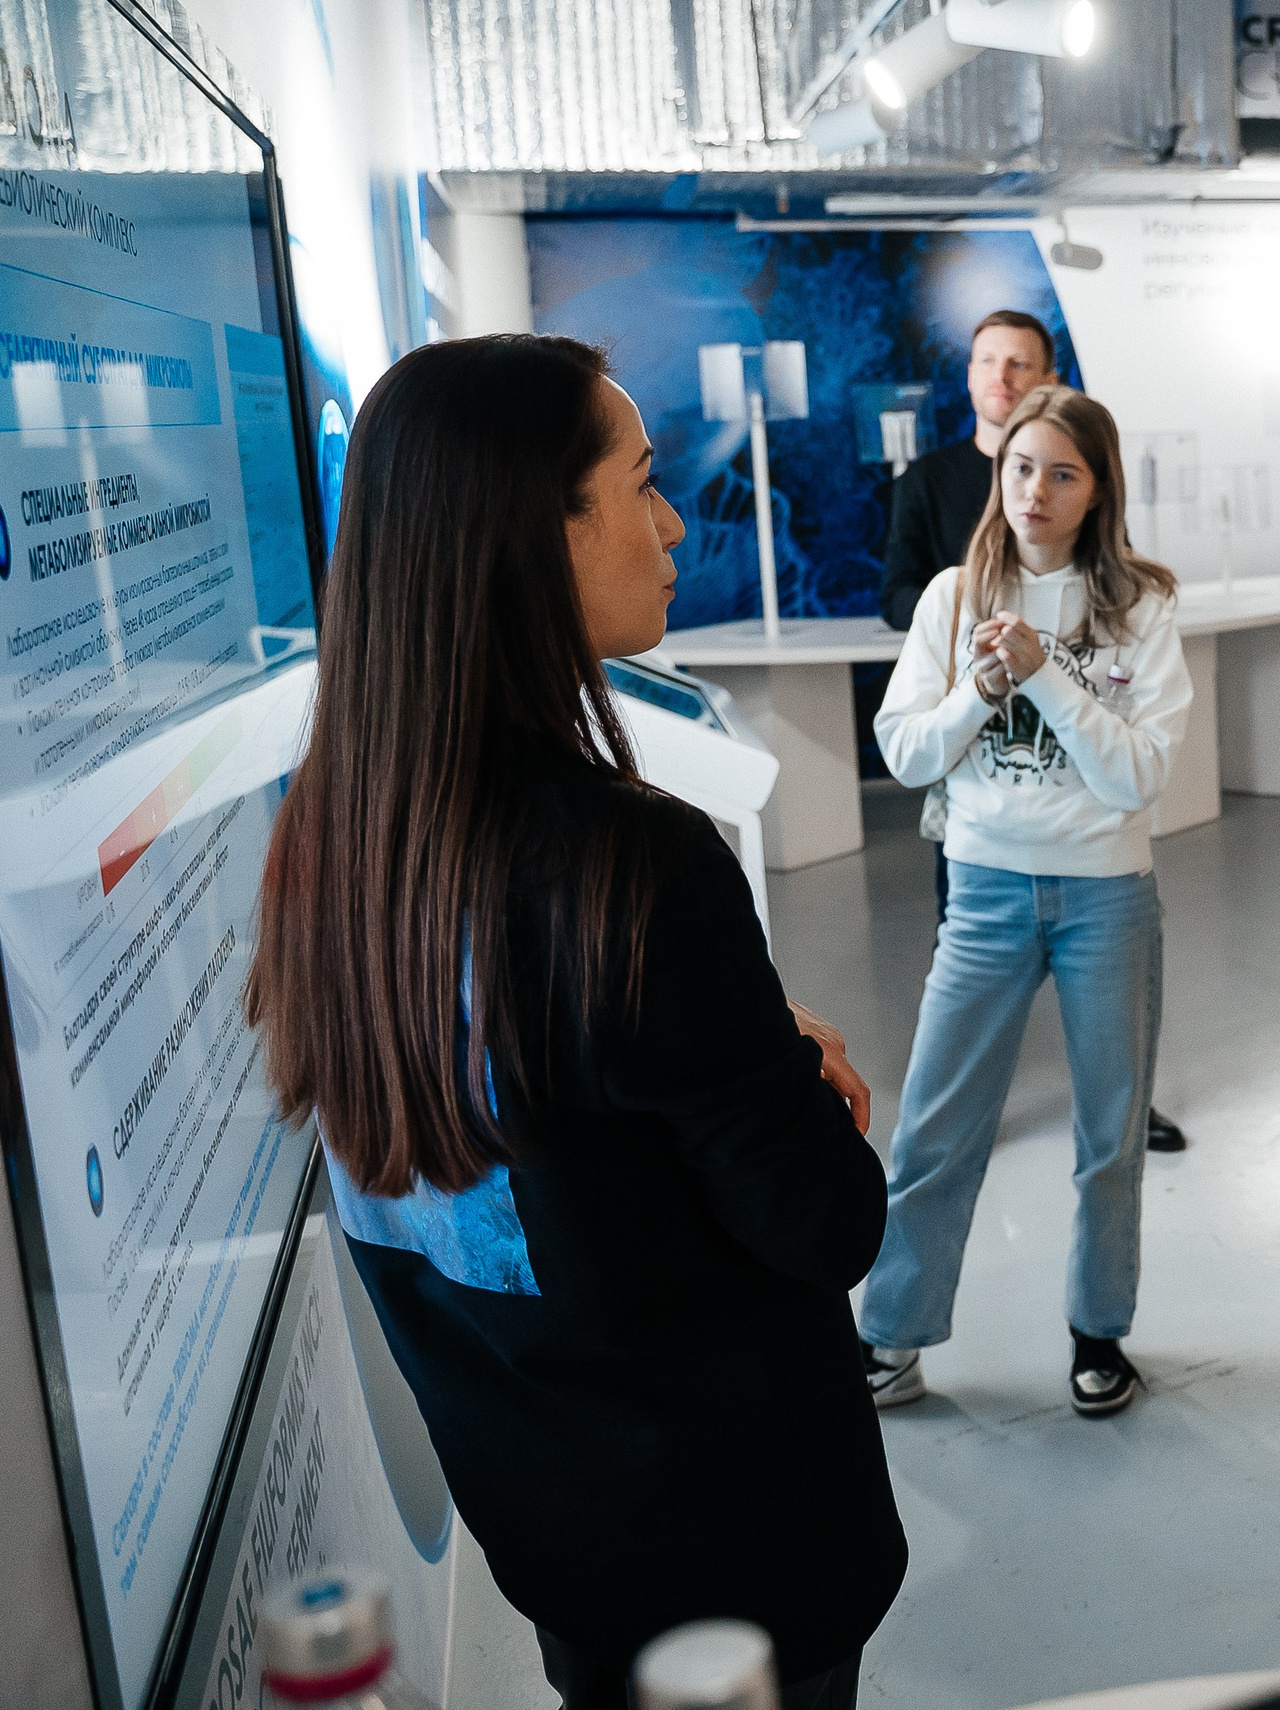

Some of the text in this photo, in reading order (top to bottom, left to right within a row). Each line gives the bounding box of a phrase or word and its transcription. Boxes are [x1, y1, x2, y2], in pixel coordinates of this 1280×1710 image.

[88, 203, 138, 256] КОМПЛЕКС
[21, 480, 90, 526] СПЕЦИАЛЬНЫЕ
[28, 523, 119, 583] МЕТАБОЛИЗИРУЕМЫЕ
[118, 502, 175, 554] КОММЕНСАЛЬНОЙ
[64, 989, 100, 1051] Благодаря
[99, 959, 119, 1003] своей
[118, 929, 147, 978] структуре
[71, 998, 121, 1089] комменсальной
[120, 943, 158, 1017] микрофлорой
[113, 1039, 168, 1160] СДЕРЖИВАНИЕ
[166, 963, 209, 1063] РАЗМНОЖЕНИЯ
[207, 922, 236, 989] ПАТОГЕНОВ
[155, 1280, 173, 1346] ущерб
[206, 1559, 258, 1710] OSAE
[251, 1355, 306, 1600] FILIFORMIS
[286, 1405, 326, 1582] FERMENT
